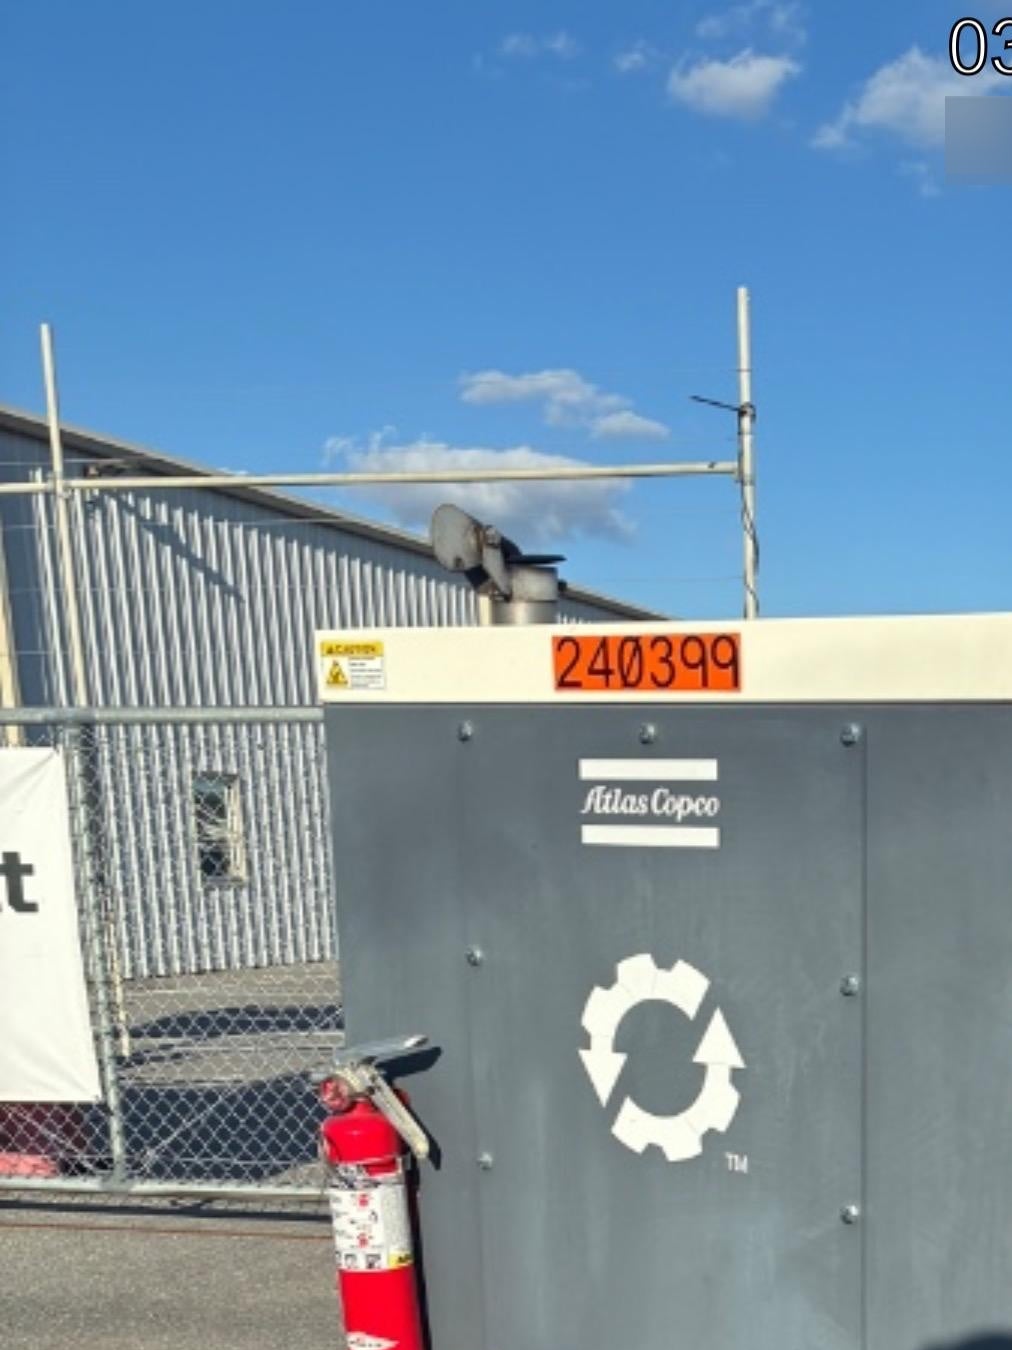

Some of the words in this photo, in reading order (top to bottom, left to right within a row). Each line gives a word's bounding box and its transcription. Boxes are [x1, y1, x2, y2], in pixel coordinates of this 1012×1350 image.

[556, 635, 739, 688] 240399
[580, 785, 649, 815] Atlas
[650, 787, 721, 823] Copco
[0, 851, 40, 913] t
